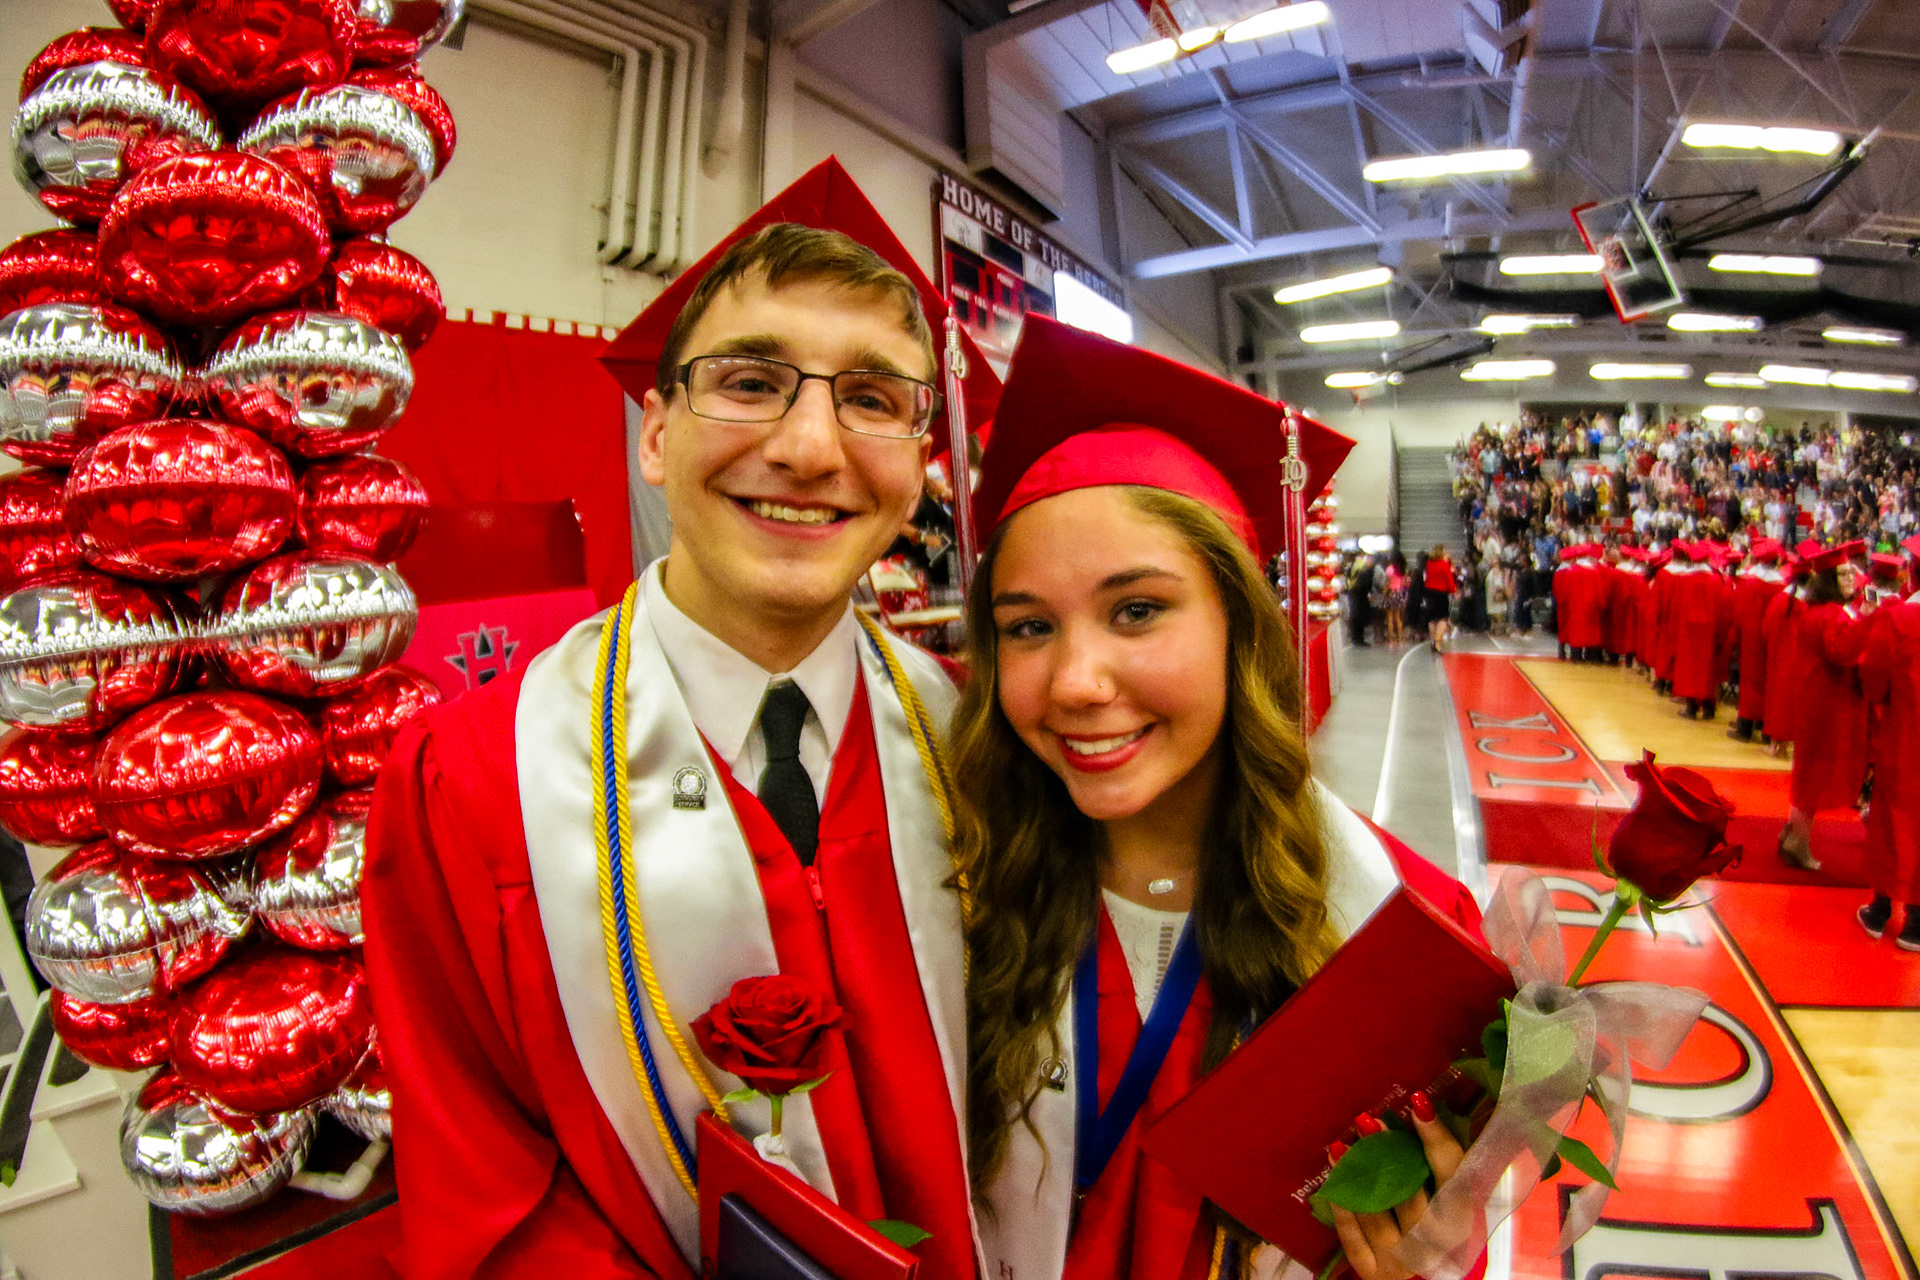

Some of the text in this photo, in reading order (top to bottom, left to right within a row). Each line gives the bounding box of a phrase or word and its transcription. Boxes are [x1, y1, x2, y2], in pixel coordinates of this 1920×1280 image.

[942, 174, 1005, 234] HOME
[1011, 220, 1032, 250] OF
[1039, 237, 1069, 273] THE
[1279, 456, 1307, 492] 19
